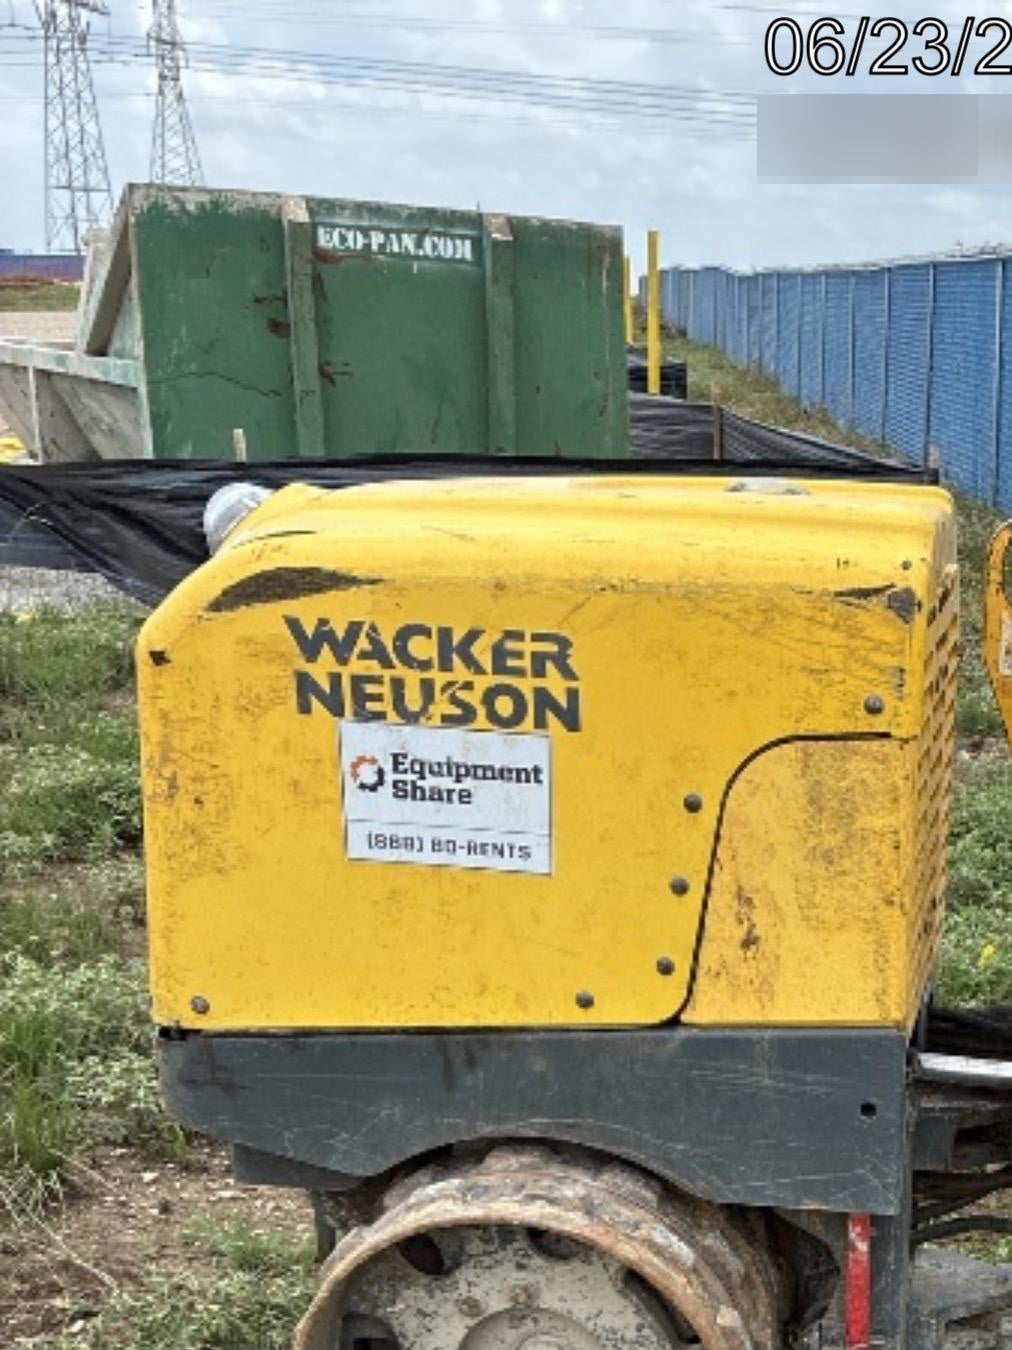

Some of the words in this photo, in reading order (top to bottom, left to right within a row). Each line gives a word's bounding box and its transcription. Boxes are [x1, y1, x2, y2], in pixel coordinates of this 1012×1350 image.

[316, 225, 473, 262] ECO-PAN.COM
[281, 614, 580, 681] WACKER
[293, 669, 583, 733] NEUSON
[390, 752, 544, 786] Equipment
[391, 779, 473, 805] Share
